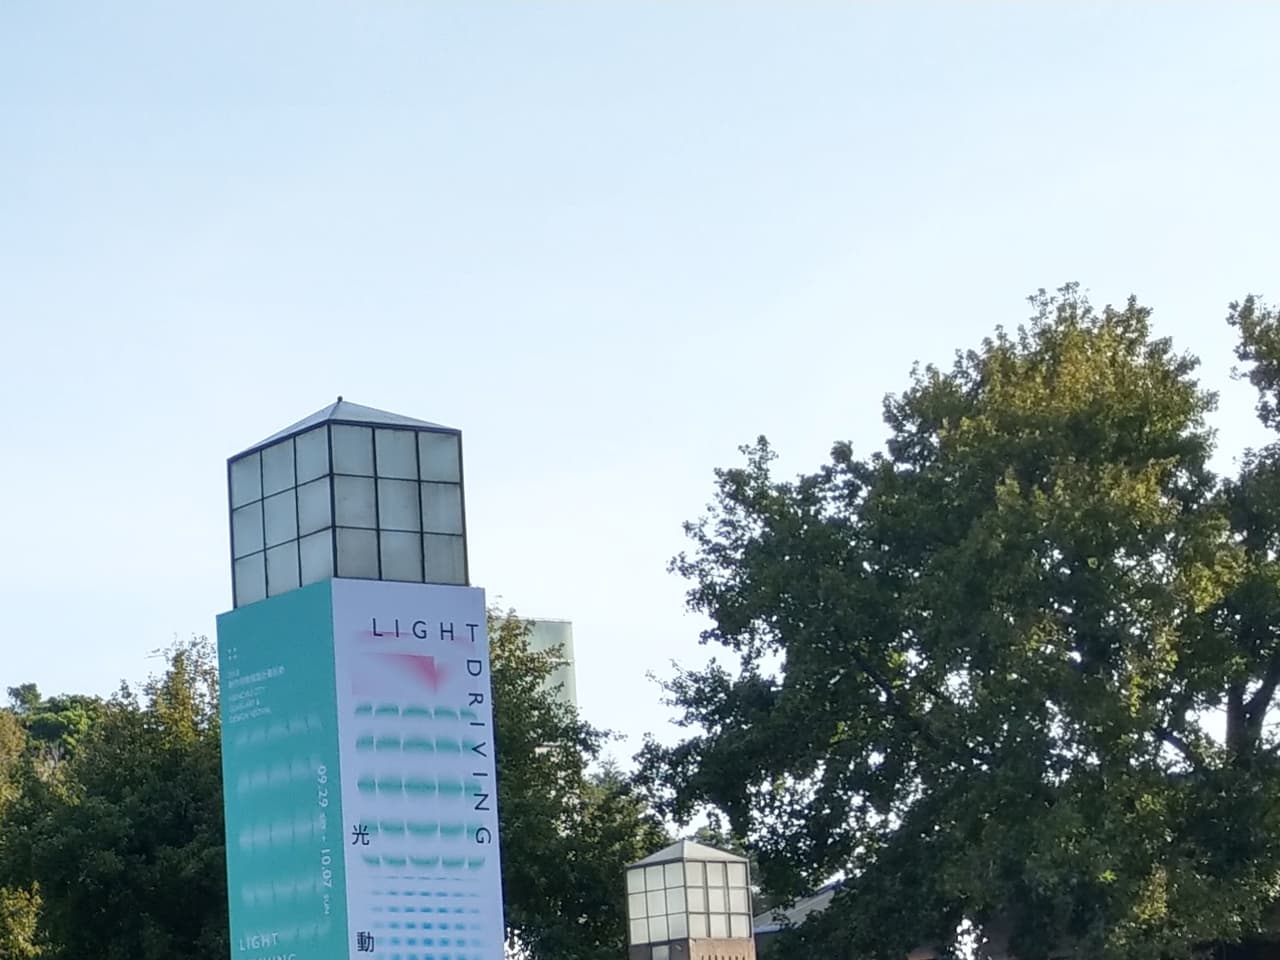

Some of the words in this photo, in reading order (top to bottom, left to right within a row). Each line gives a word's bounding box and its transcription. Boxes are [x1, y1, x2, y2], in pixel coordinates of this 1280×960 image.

[372, 617, 479, 642] LIGHT
[466, 658, 492, 844] DRIVING
[351, 824, 370, 846] 光
[240, 932, 279, 951] LIGHT
[356, 931, 375, 953] 動
